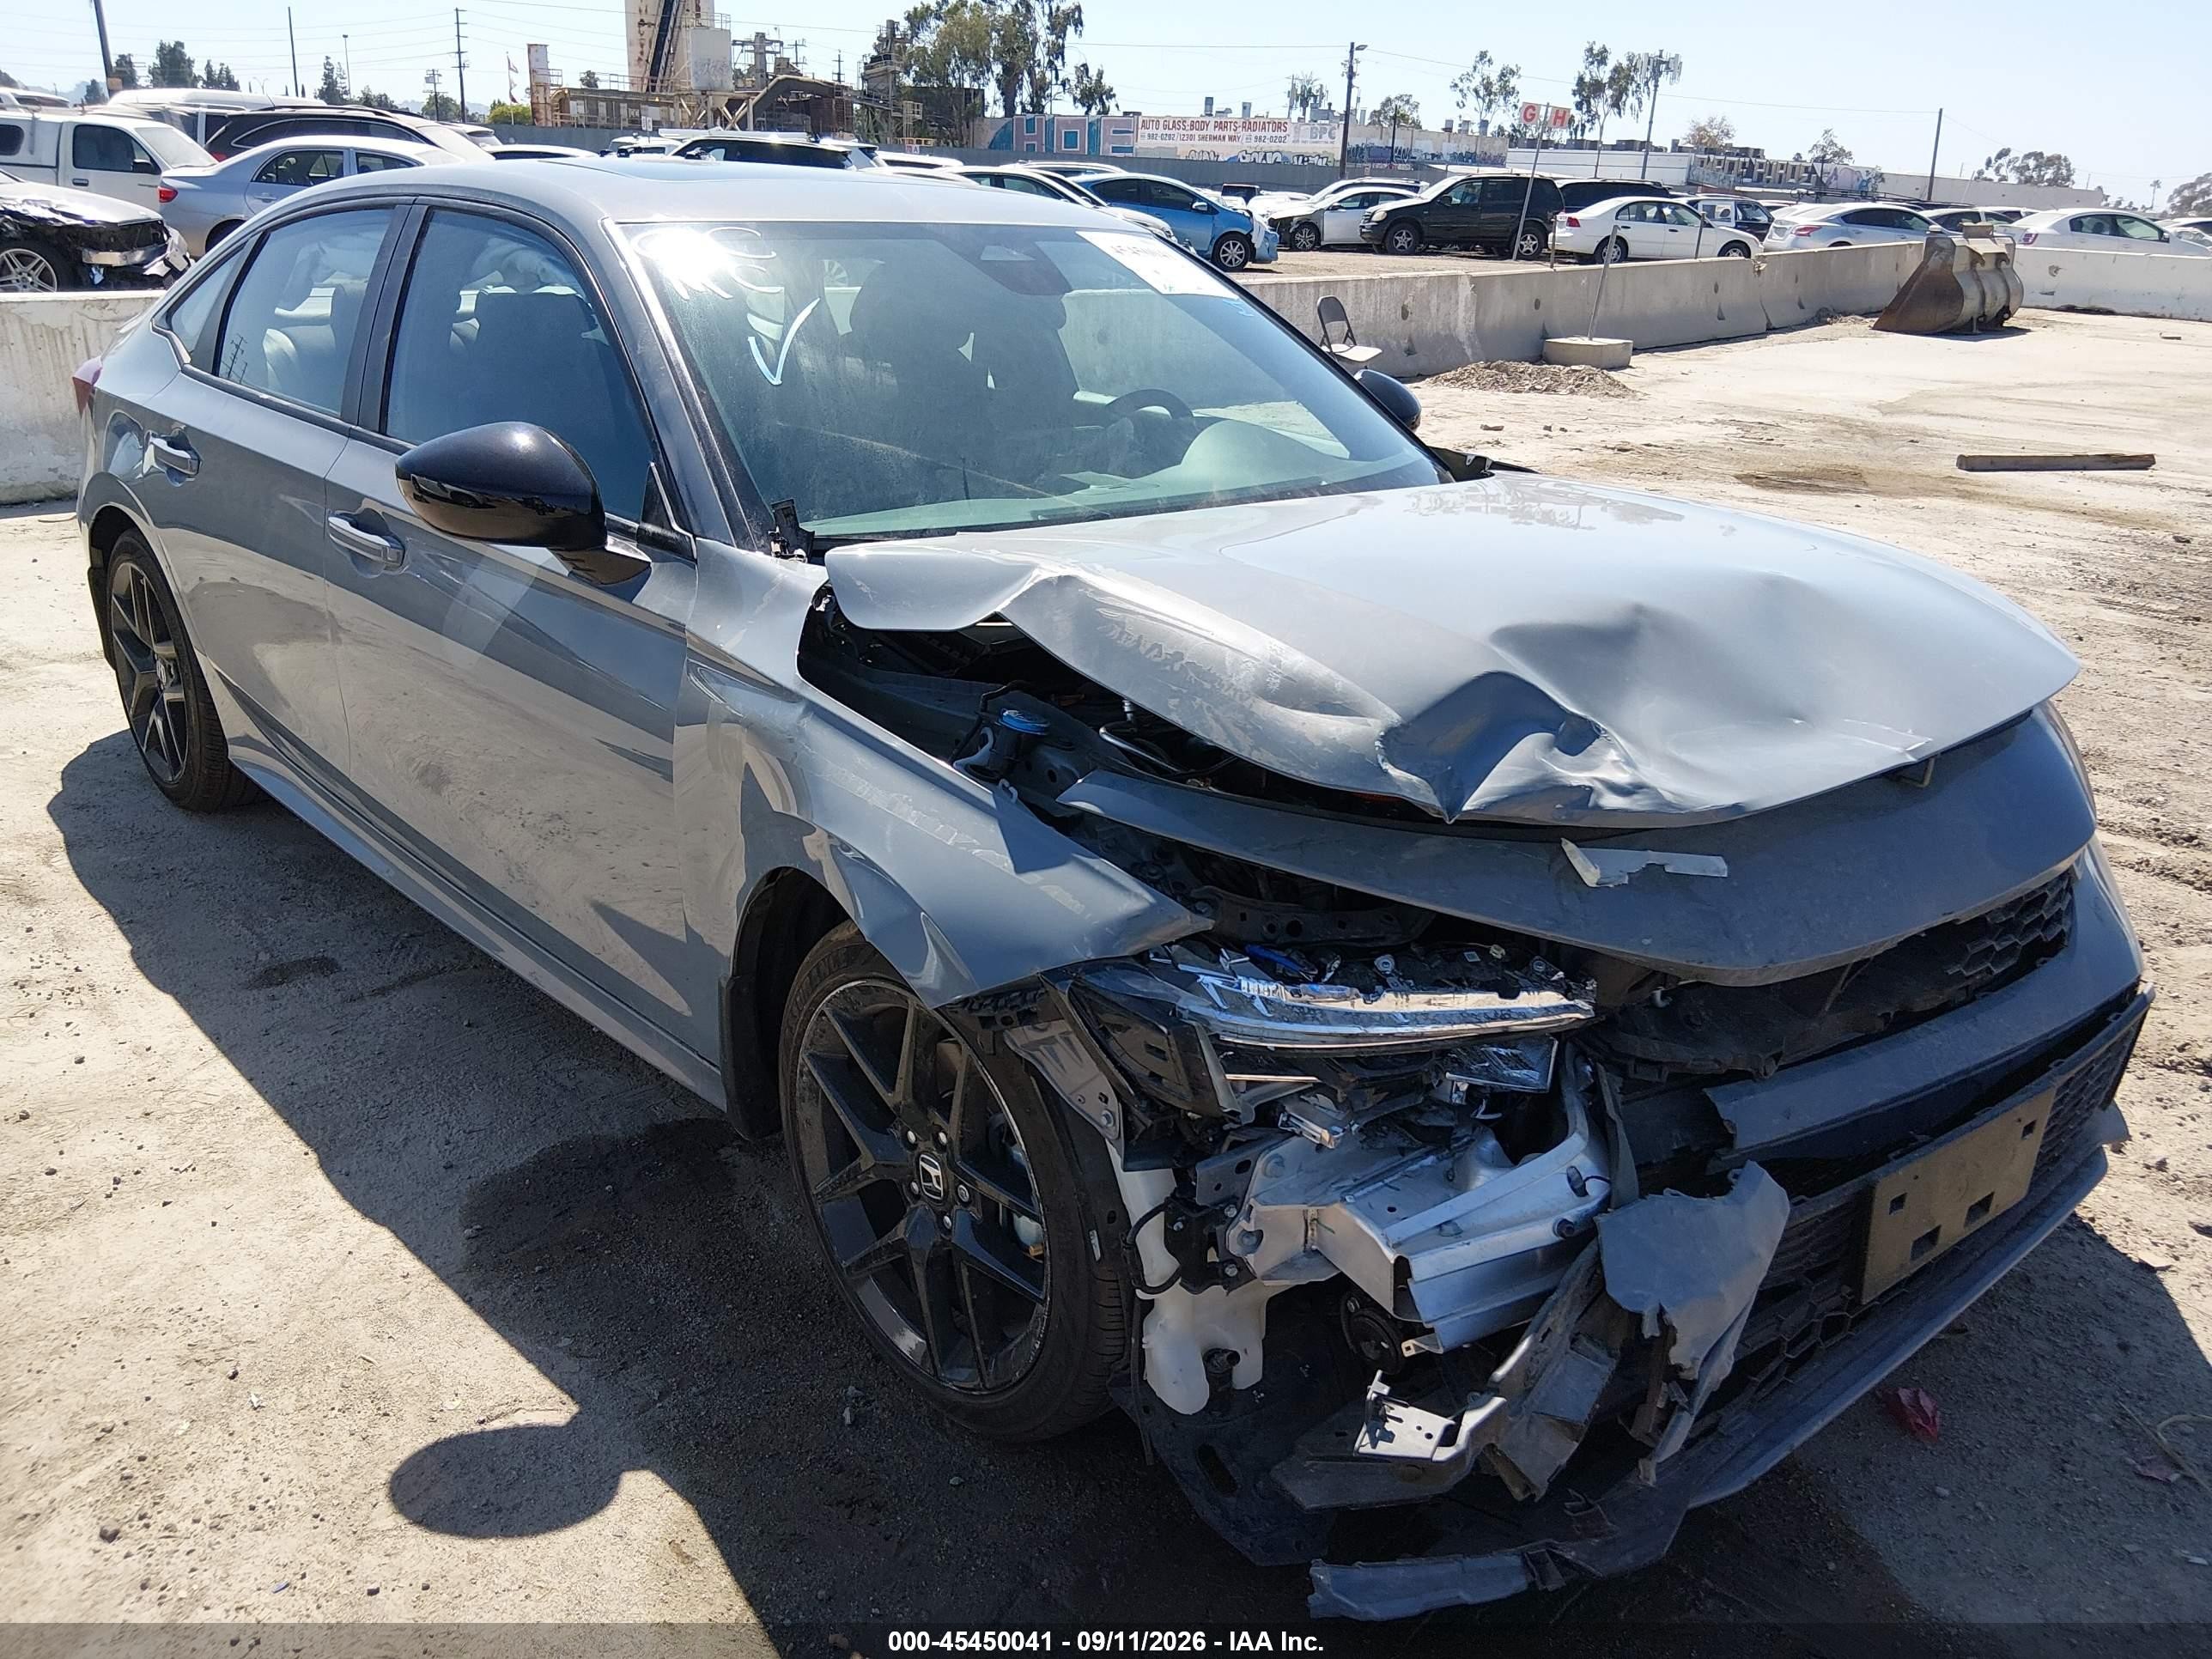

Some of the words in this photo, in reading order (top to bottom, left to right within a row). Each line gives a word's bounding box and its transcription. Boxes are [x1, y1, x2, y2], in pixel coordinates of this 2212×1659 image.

[1522, 105, 1536, 123] G
[1553, 109, 1567, 126] H
[1140, 119, 1160, 131] AUTO
